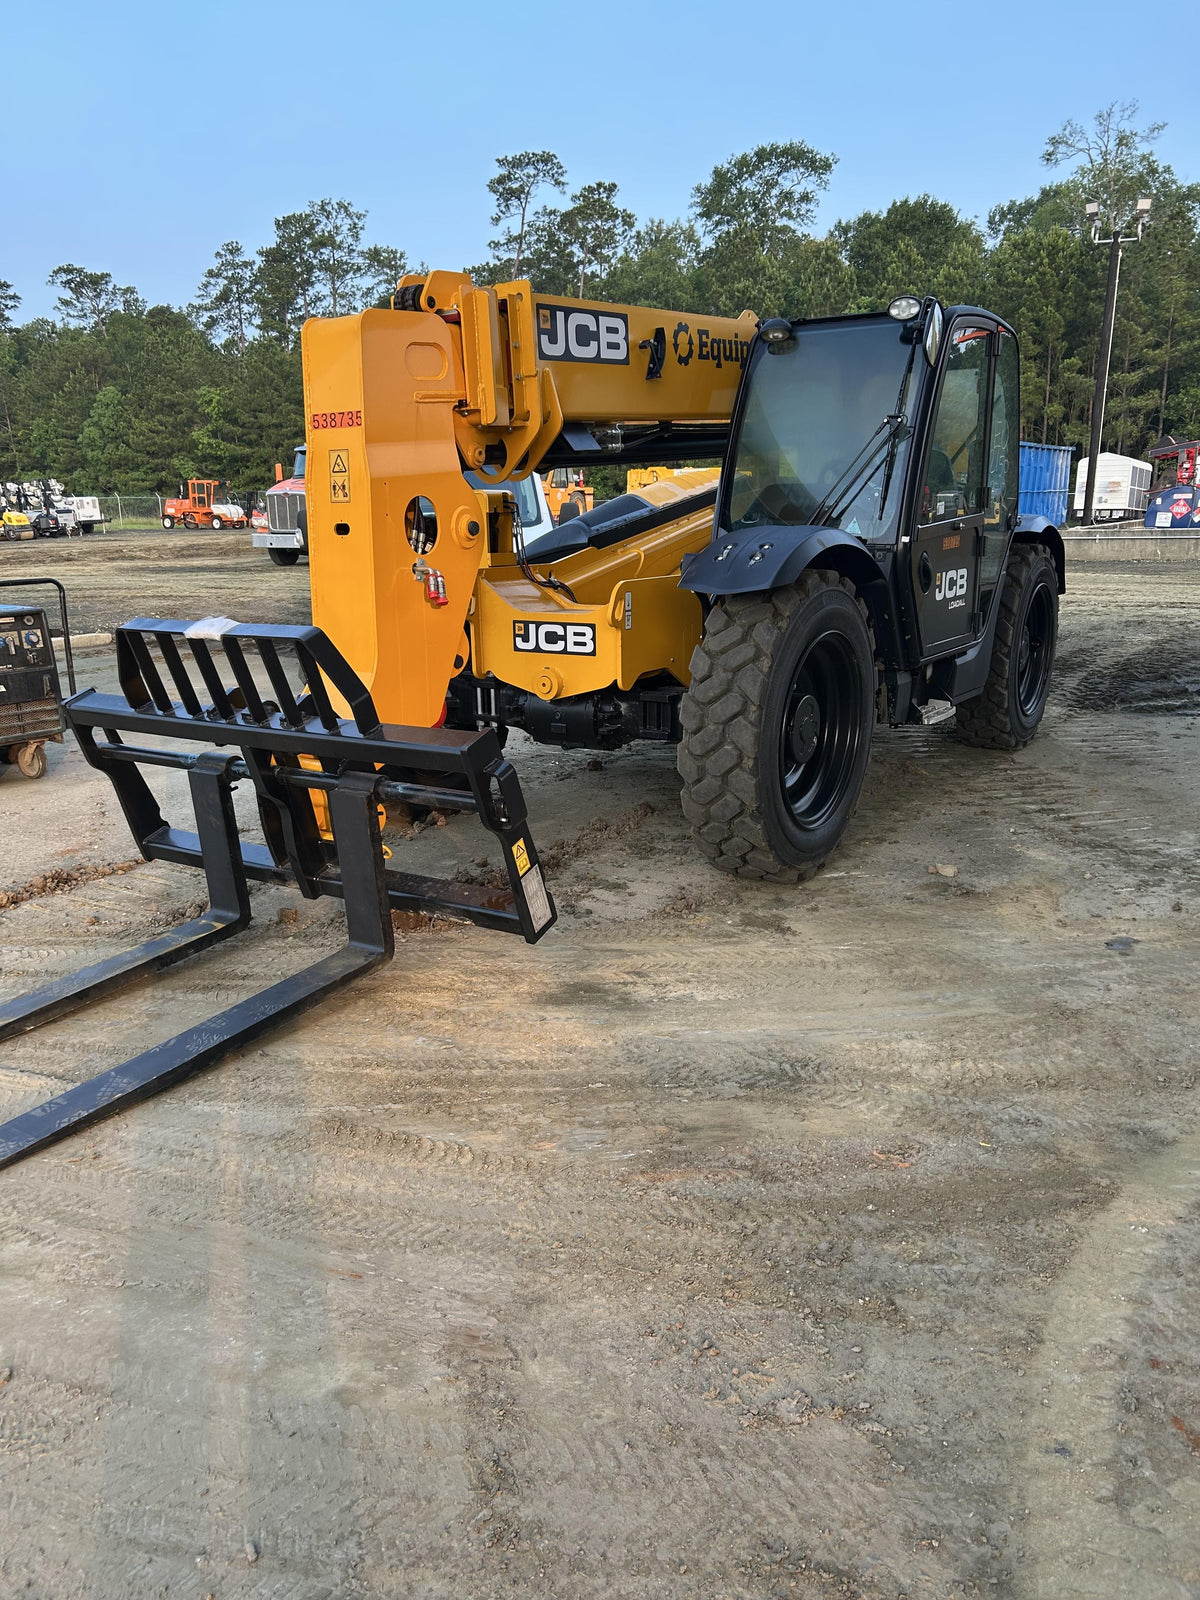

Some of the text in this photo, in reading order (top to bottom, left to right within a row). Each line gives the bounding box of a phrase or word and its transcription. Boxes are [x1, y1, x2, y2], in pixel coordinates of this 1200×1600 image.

[540, 310, 628, 360] JCB
[697, 328, 750, 370] Equip
[312, 410, 362, 429] 538735
[935, 567, 968, 601] JCB
[515, 623, 595, 653] JCB
